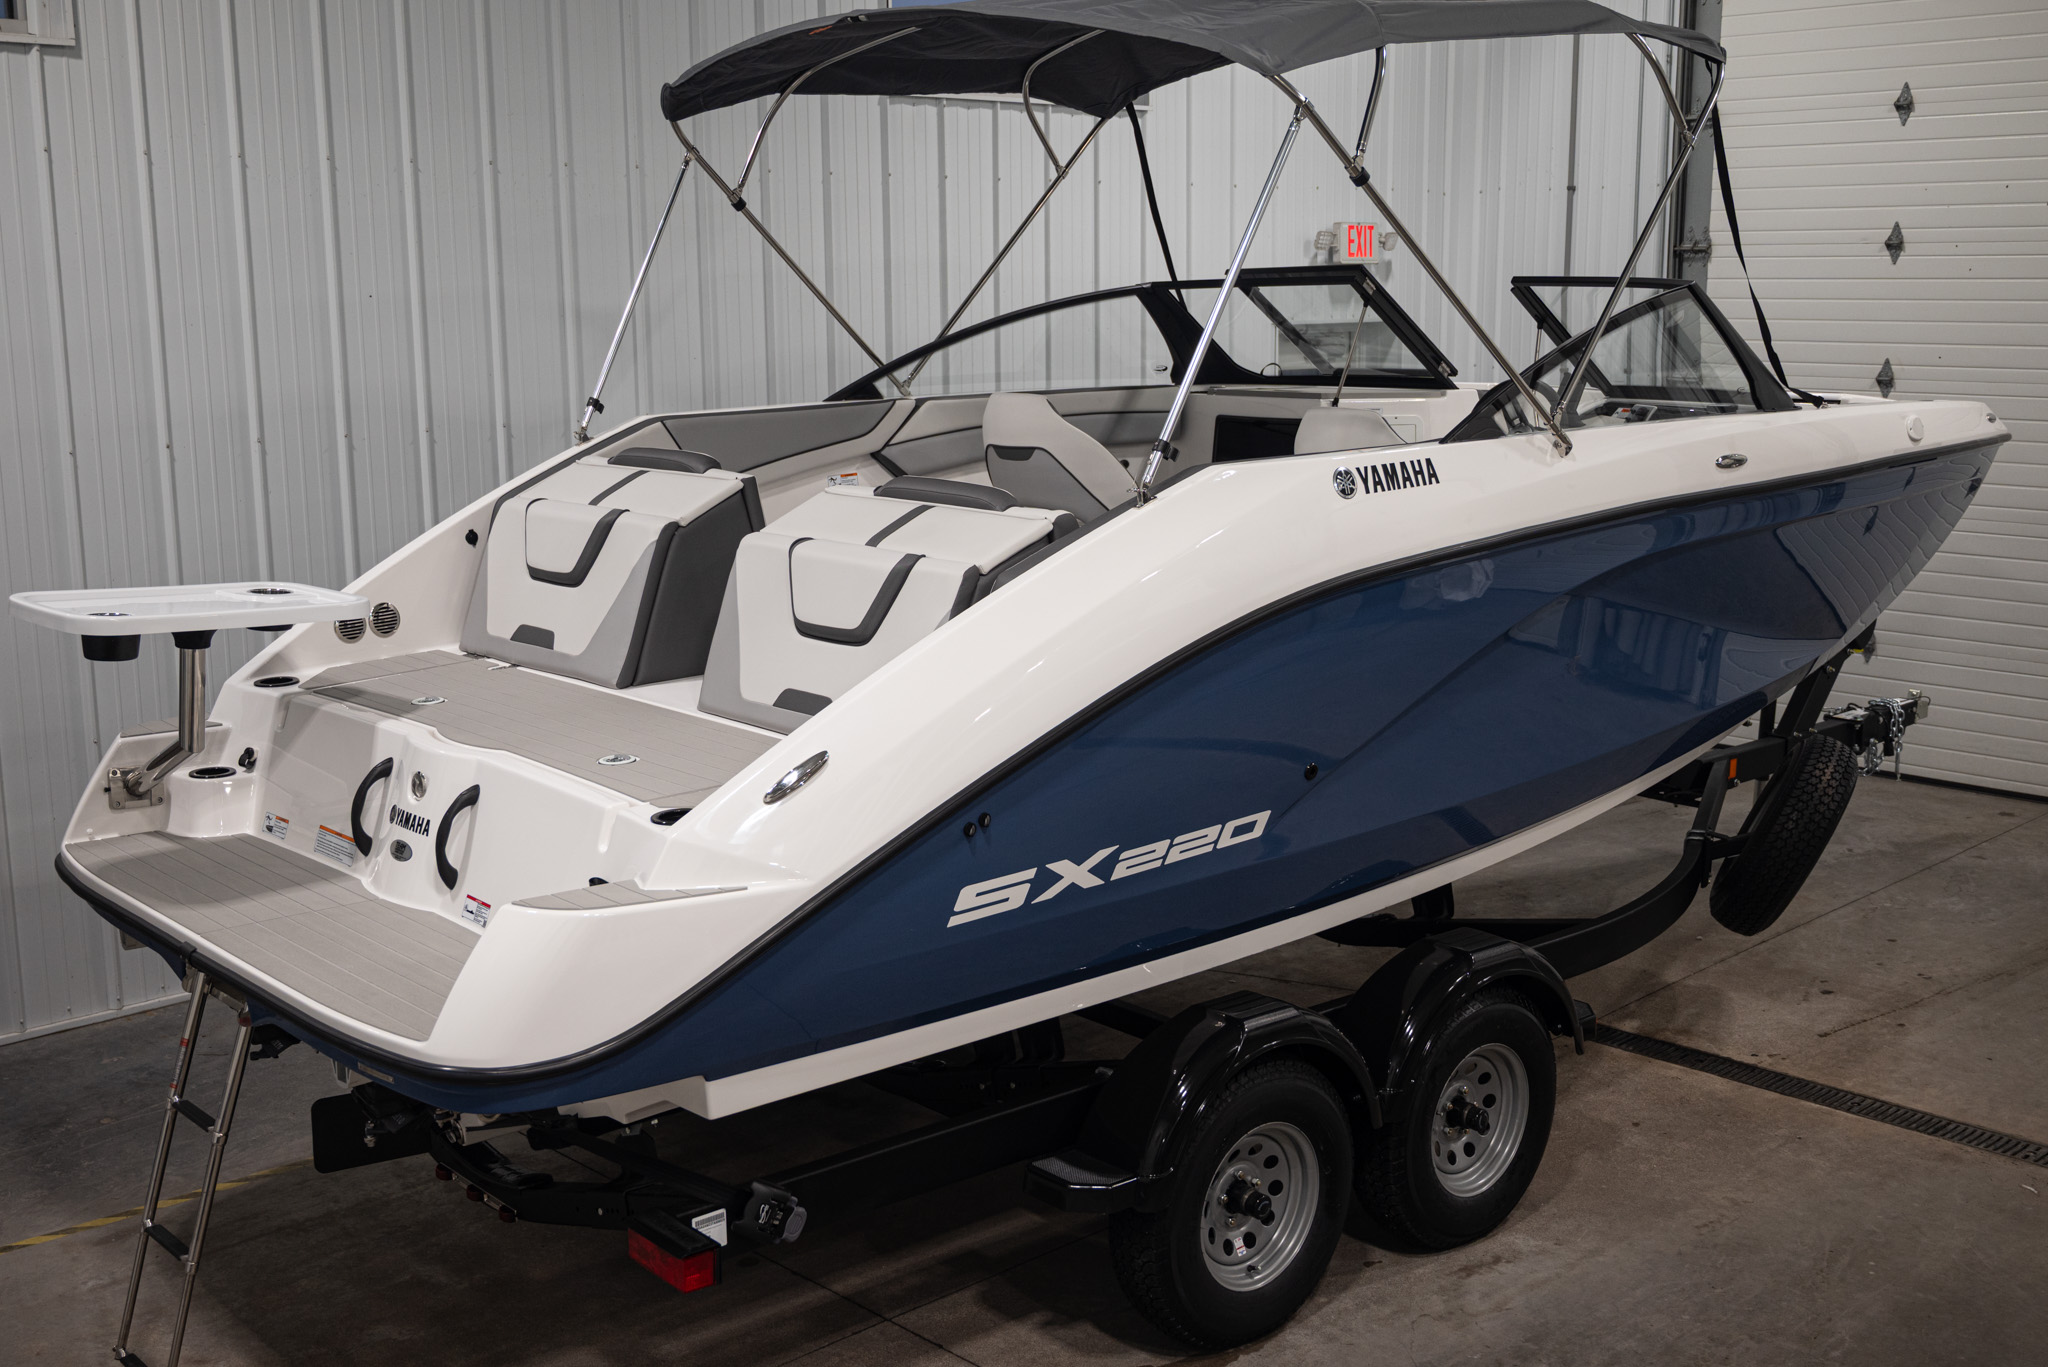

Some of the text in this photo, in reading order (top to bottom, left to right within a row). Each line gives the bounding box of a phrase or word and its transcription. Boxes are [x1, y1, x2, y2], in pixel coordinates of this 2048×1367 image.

[1347, 225, 1374, 258] EXIT
[1355, 457, 1440, 494] YAMAHA
[395, 807, 431, 837] YAMAHA
[946, 810, 1272, 928] SX220
